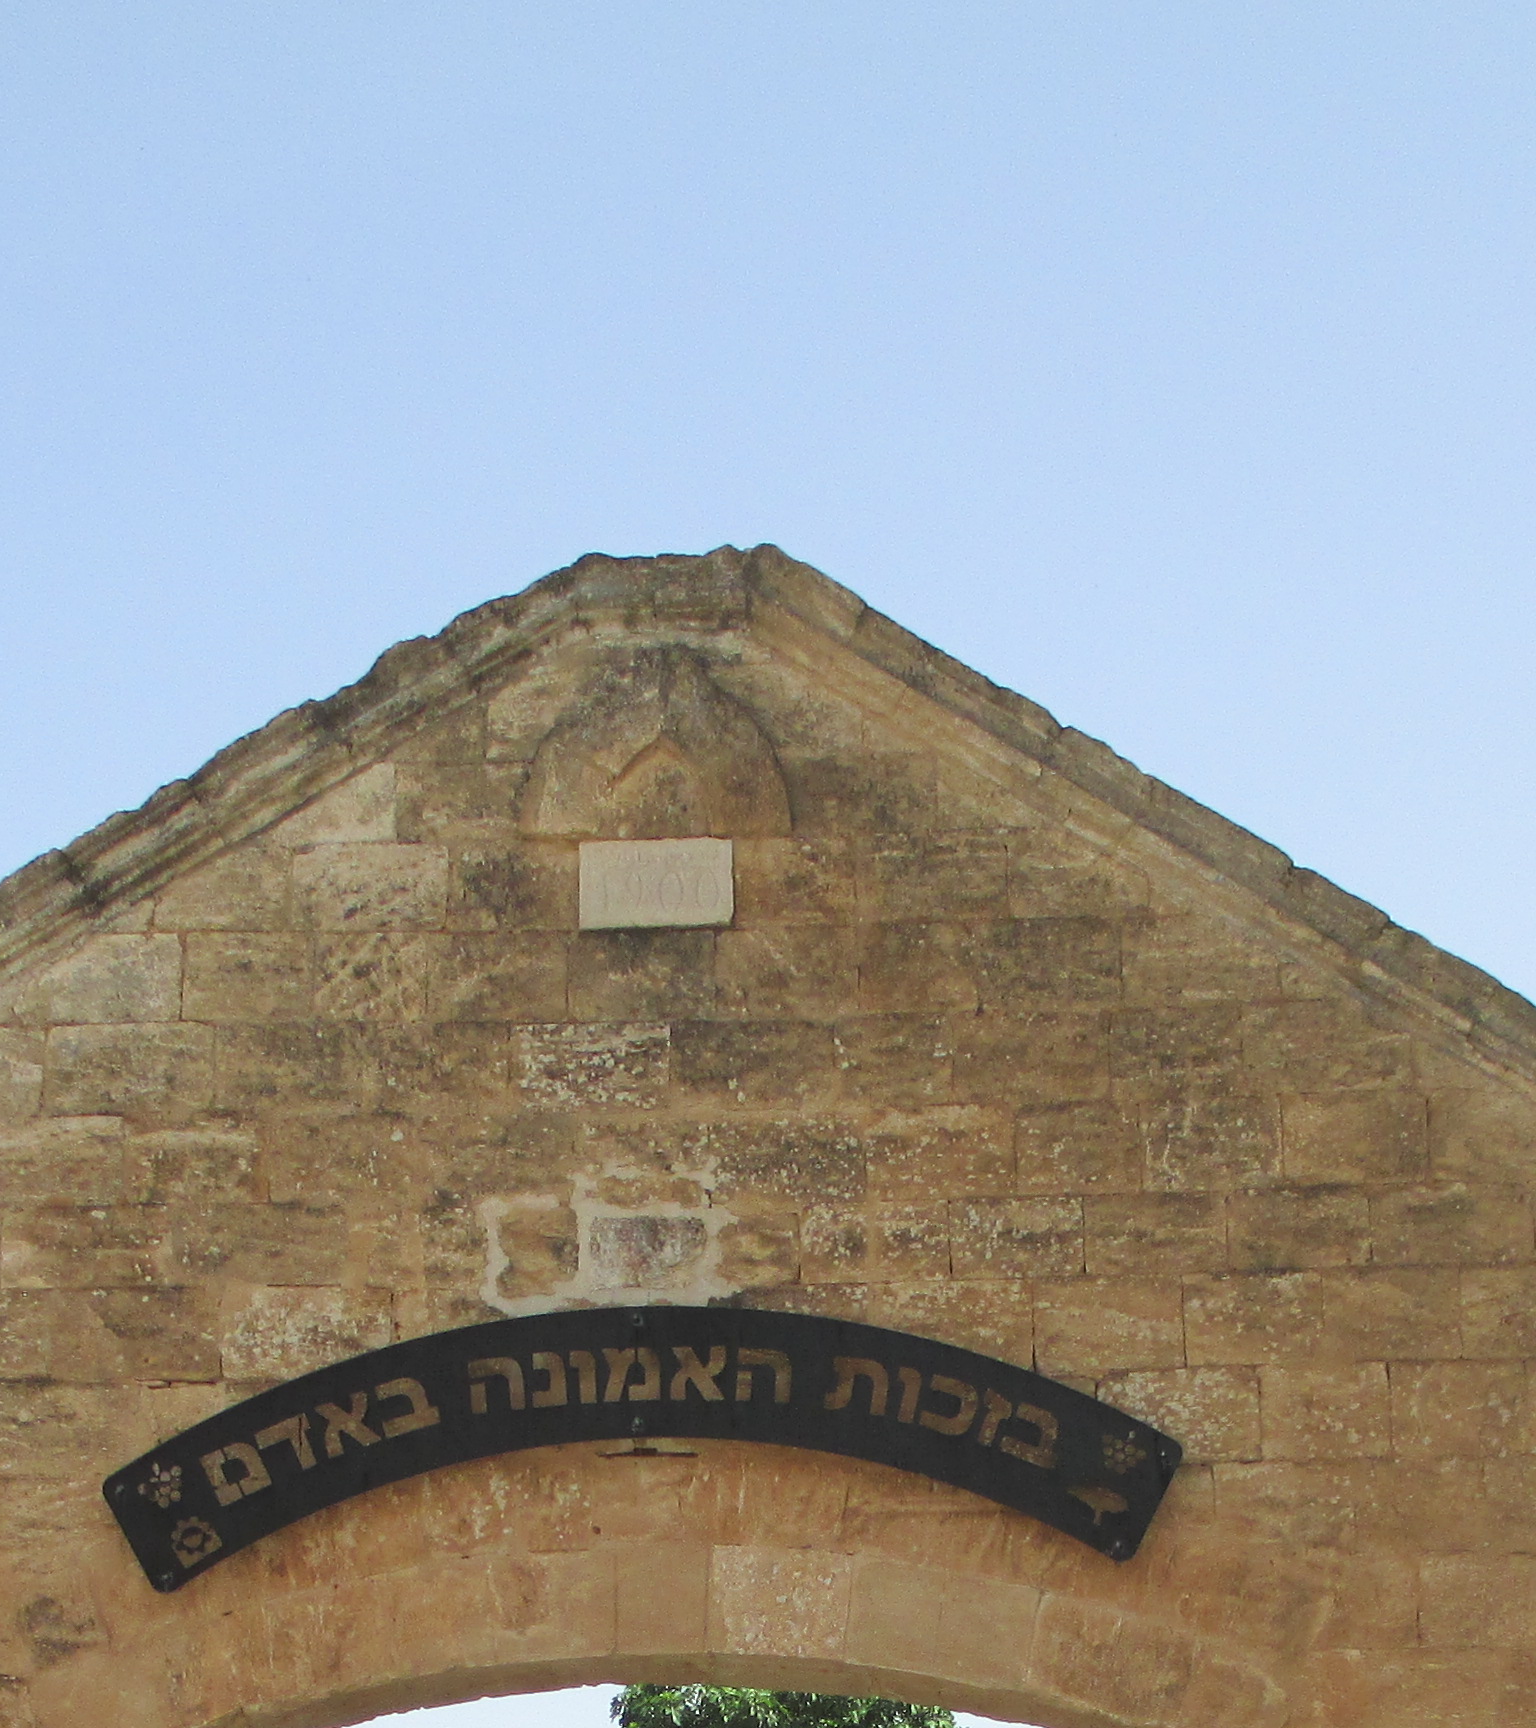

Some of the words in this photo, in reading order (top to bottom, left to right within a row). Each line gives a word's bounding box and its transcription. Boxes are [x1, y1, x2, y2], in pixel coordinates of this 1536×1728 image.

[466, 1344, 794, 1416] האמונה
[822, 1354, 1066, 1470] בזכות
[198, 1370, 442, 1507] באדם
